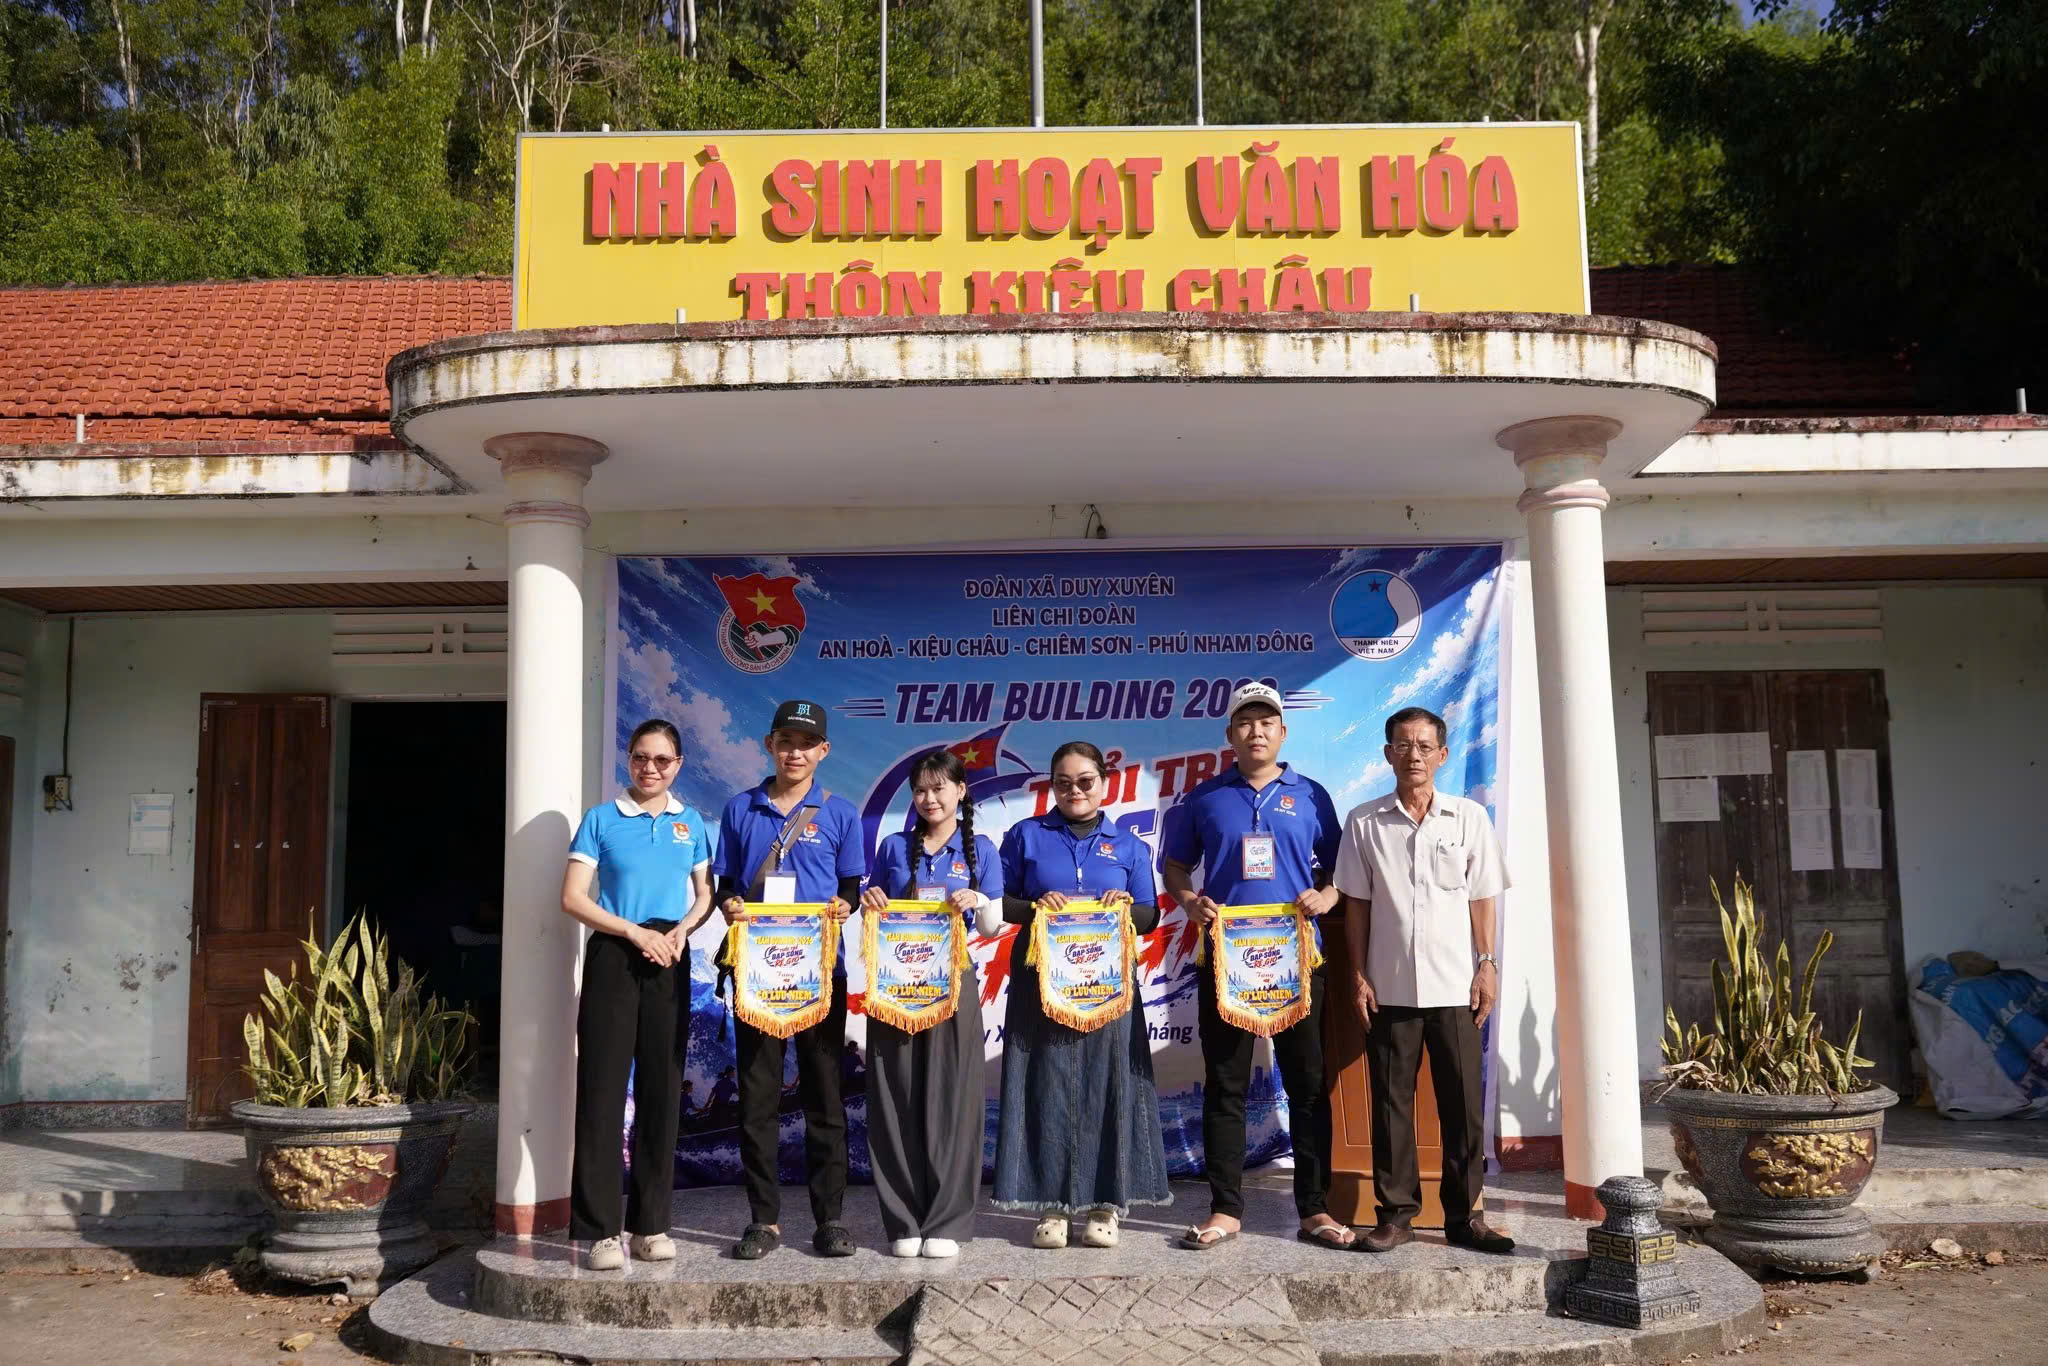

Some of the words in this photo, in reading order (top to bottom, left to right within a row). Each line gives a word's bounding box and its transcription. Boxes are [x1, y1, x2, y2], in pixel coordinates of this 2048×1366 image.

[591, 144, 737, 238] NHÀ
[771, 159, 942, 237] SINH
[976, 156, 1162, 249] HOẠT
[1196, 140, 1341, 232] VĂN
[1371, 137, 1519, 232] HÓA
[735, 259, 943, 320] THÔN
[1173, 254, 1373, 313] CHÂU
[964, 574, 1022, 598] ĐOÀN
[1028, 574, 1056, 598] XÃ
[1060, 577, 1102, 597] DUY
[1105, 572, 1174, 597] XUYÊN
[992, 602, 1036, 627] LIÊN
[1039, 606, 1073, 626] CHI
[1077, 602, 1136, 626] ĐOÀN
[818, 639, 848, 659] AN
[852, 634, 894, 658] HOÀ
[908, 635, 952, 662] KIỆU
[956, 633, 1010, 658] CHÂU
[1025, 632, 1087, 656] CHIÊM
[1090, 634, 1133, 655] SƠN
[1148, 630, 1189, 655] PHÚ
[1193, 633, 1251, 654] NHAM
[1255, 628, 1314, 653] ĐÔNG
[895, 681, 996, 723] TEAM
[1002, 678, 1176, 722] BUILDING
[757, 935, 770, 945] TEAM
[886, 932, 900, 942] TEAM
[1056, 935, 1070, 944] TEAM
[1232, 937, 1248, 947] TEAM
[1148, 1021, 1193, 1045] háng
